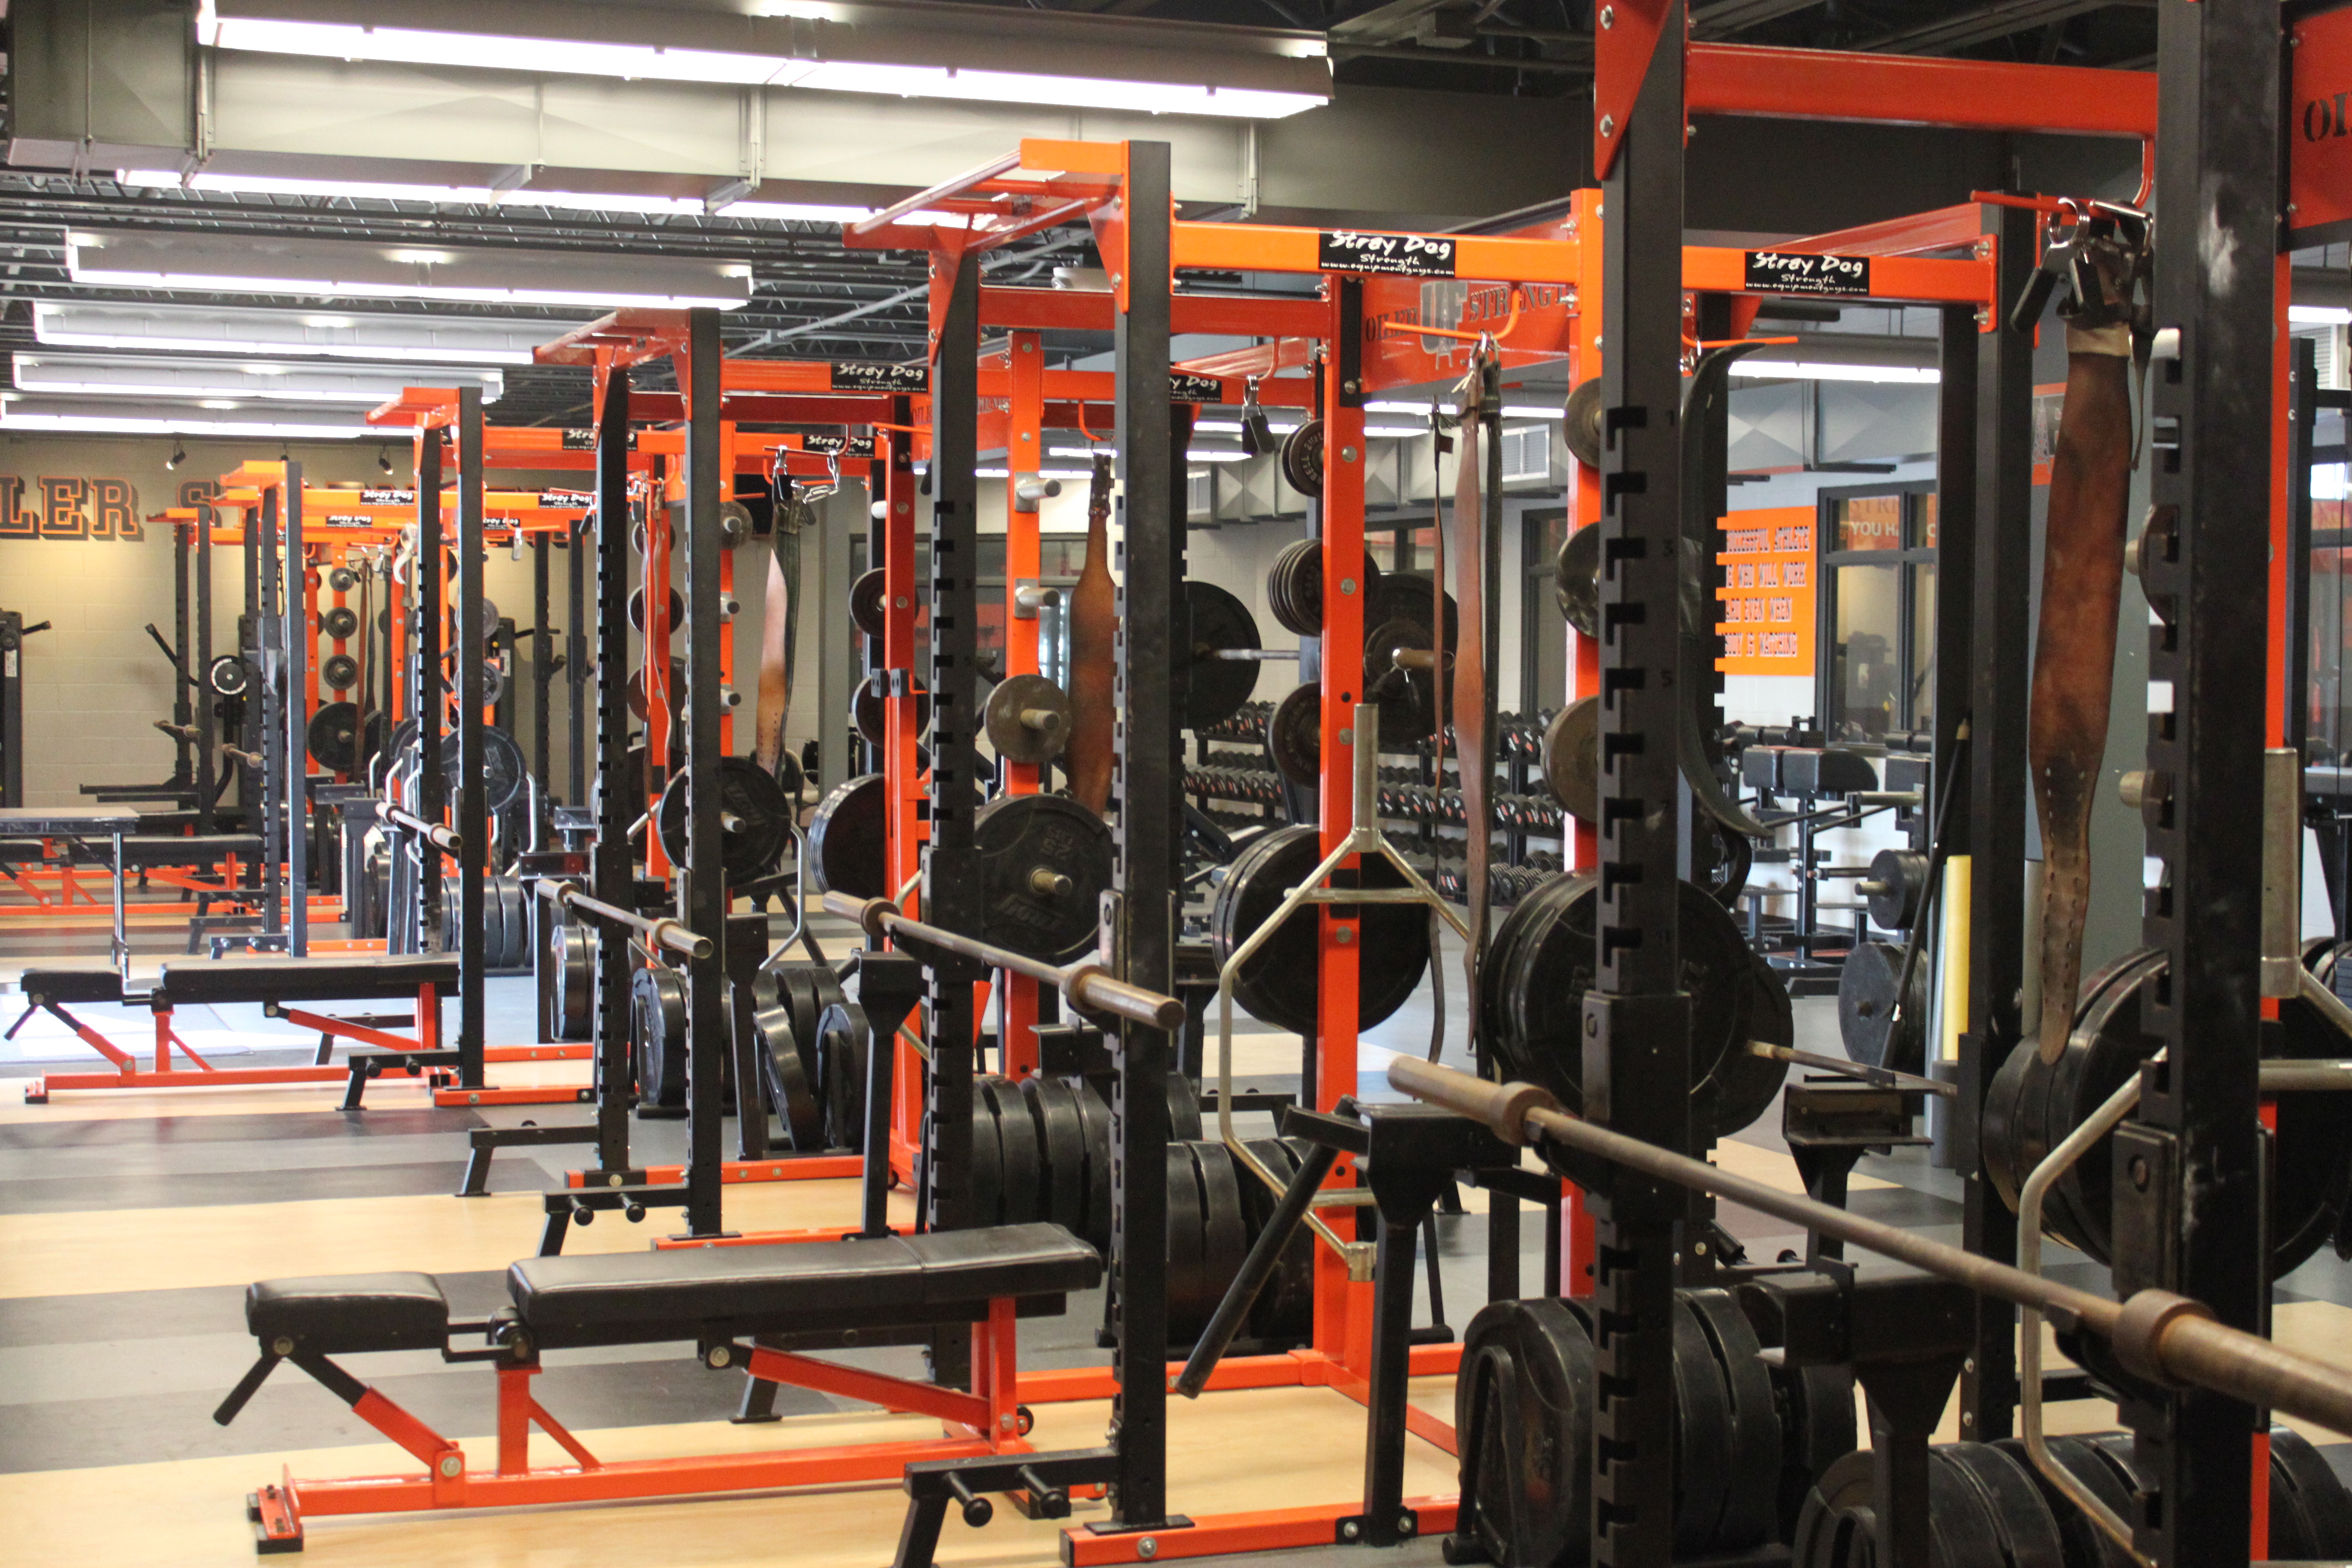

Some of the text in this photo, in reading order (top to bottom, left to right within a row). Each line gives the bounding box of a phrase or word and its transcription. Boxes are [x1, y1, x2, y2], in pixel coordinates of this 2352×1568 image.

[1329, 230, 1451, 261] Stray Dog
[1360, 253, 1420, 268] Strength
[1753, 251, 1863, 279] Stray Dog
[1321, 262, 1454, 276] www.equipmentguys.com
[1746, 282, 1867, 294] www.equipmentguys.com
[1780, 273, 1835, 287] Strength
[837, 363, 924, 381] Stray Dog
[859, 378, 902, 388] Strength
[1186, 375, 1218, 391] Dog
[807, 435, 843, 448] Stray
[542, 492, 569, 503] Stray
[1852, 521, 1881, 537] YOU
[1725, 526, 1811, 555] UCCESSFUL ATHLETE
[1738, 563, 1755, 588] WHO
[1758, 562, 1779, 588] WILL
[1783, 561, 1807, 588] WORK
[1724, 597, 1793, 623] ARD EVEN WHEN
[1746, 632, 1755, 657] IS
[1759, 632, 1798, 658] WATCHING
